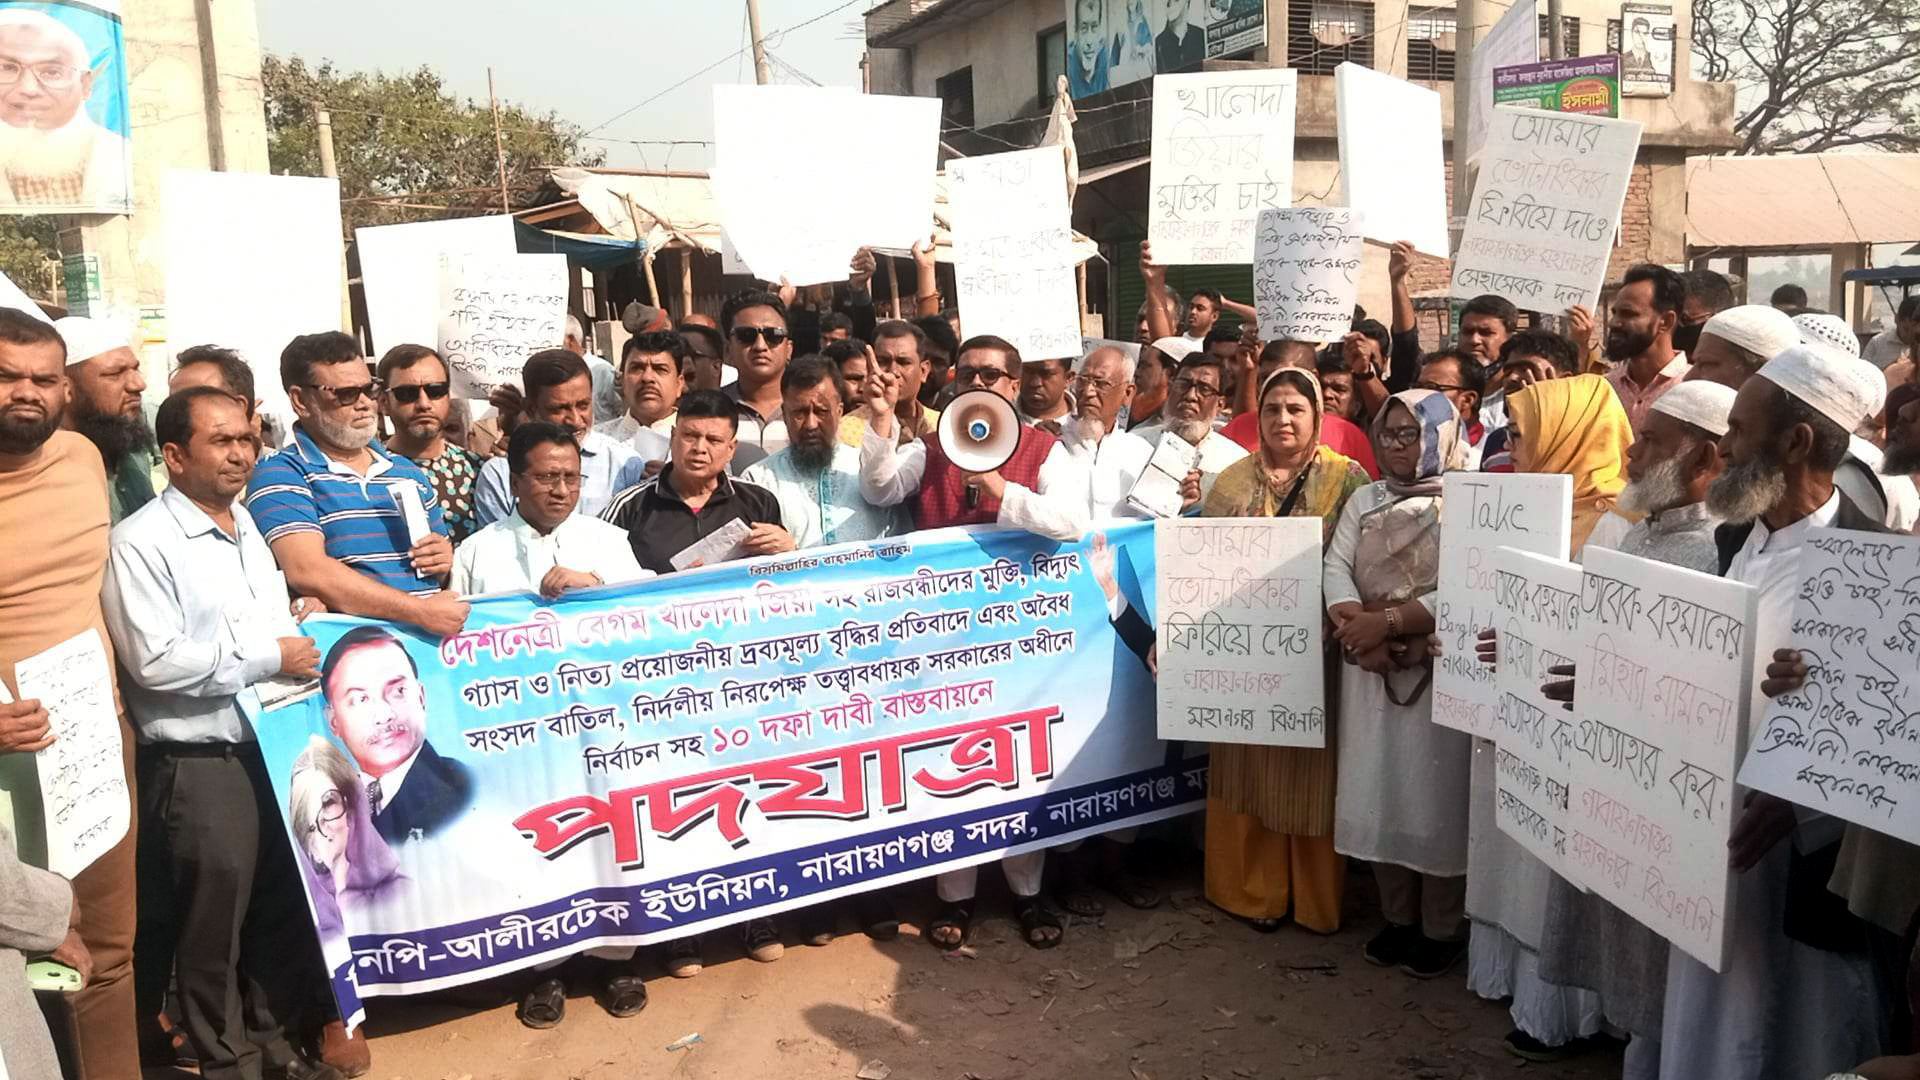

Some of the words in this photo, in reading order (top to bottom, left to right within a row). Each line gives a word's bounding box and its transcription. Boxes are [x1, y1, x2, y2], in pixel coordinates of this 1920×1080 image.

[1511, 113, 1606, 154] আমার
[1463, 483, 1529, 532] Take
[441, 611, 562, 666] দেশনেত্রী
[576, 608, 648, 644] বেগম
[1032, 554, 1081, 580] বিদ্যুৎ
[462, 677, 520, 710] গ্যাস
[529, 676, 551, 697] ও
[556, 657, 613, 695] নিত্য
[620, 644, 733, 684] প্রয়োজনীয়
[738, 632, 822, 669] দ্রব্যমূল্য
[828, 620, 880, 657] বৃদ্ধির
[886, 606, 971, 642] প্রতিবাদে
[976, 604, 1017, 627] এবং
[1022, 592, 1073, 619] অবৈধ
[464, 720, 536, 754] সংসদ
[546, 703, 626, 739] বাতিল,
[630, 684, 714, 726] নির্দলীয়
[718, 675, 808, 707] নিরপেক্ষ
[927, 638, 1012, 671] সরকারের
[1017, 628, 1075, 660] অধীনে
[582, 739, 661, 777] নির্বাচন
[669, 735, 704, 760] সহ
[711, 725, 751, 754] ১০
[758, 709, 815, 745] দফা
[820, 692, 874, 733] দাবী
[880, 676, 995, 722] বাস্তবায়নে
[512, 704, 1066, 872] পদযাত্রা
[346, 895, 632, 978] নপি-আলীরটেক
[640, 860, 790, 923] ইউনিয়ন,
[799, 826, 957, 886] নারায়ণগঞ্জ
[1046, 770, 1180, 828] নারায়ণগঞ্জ
